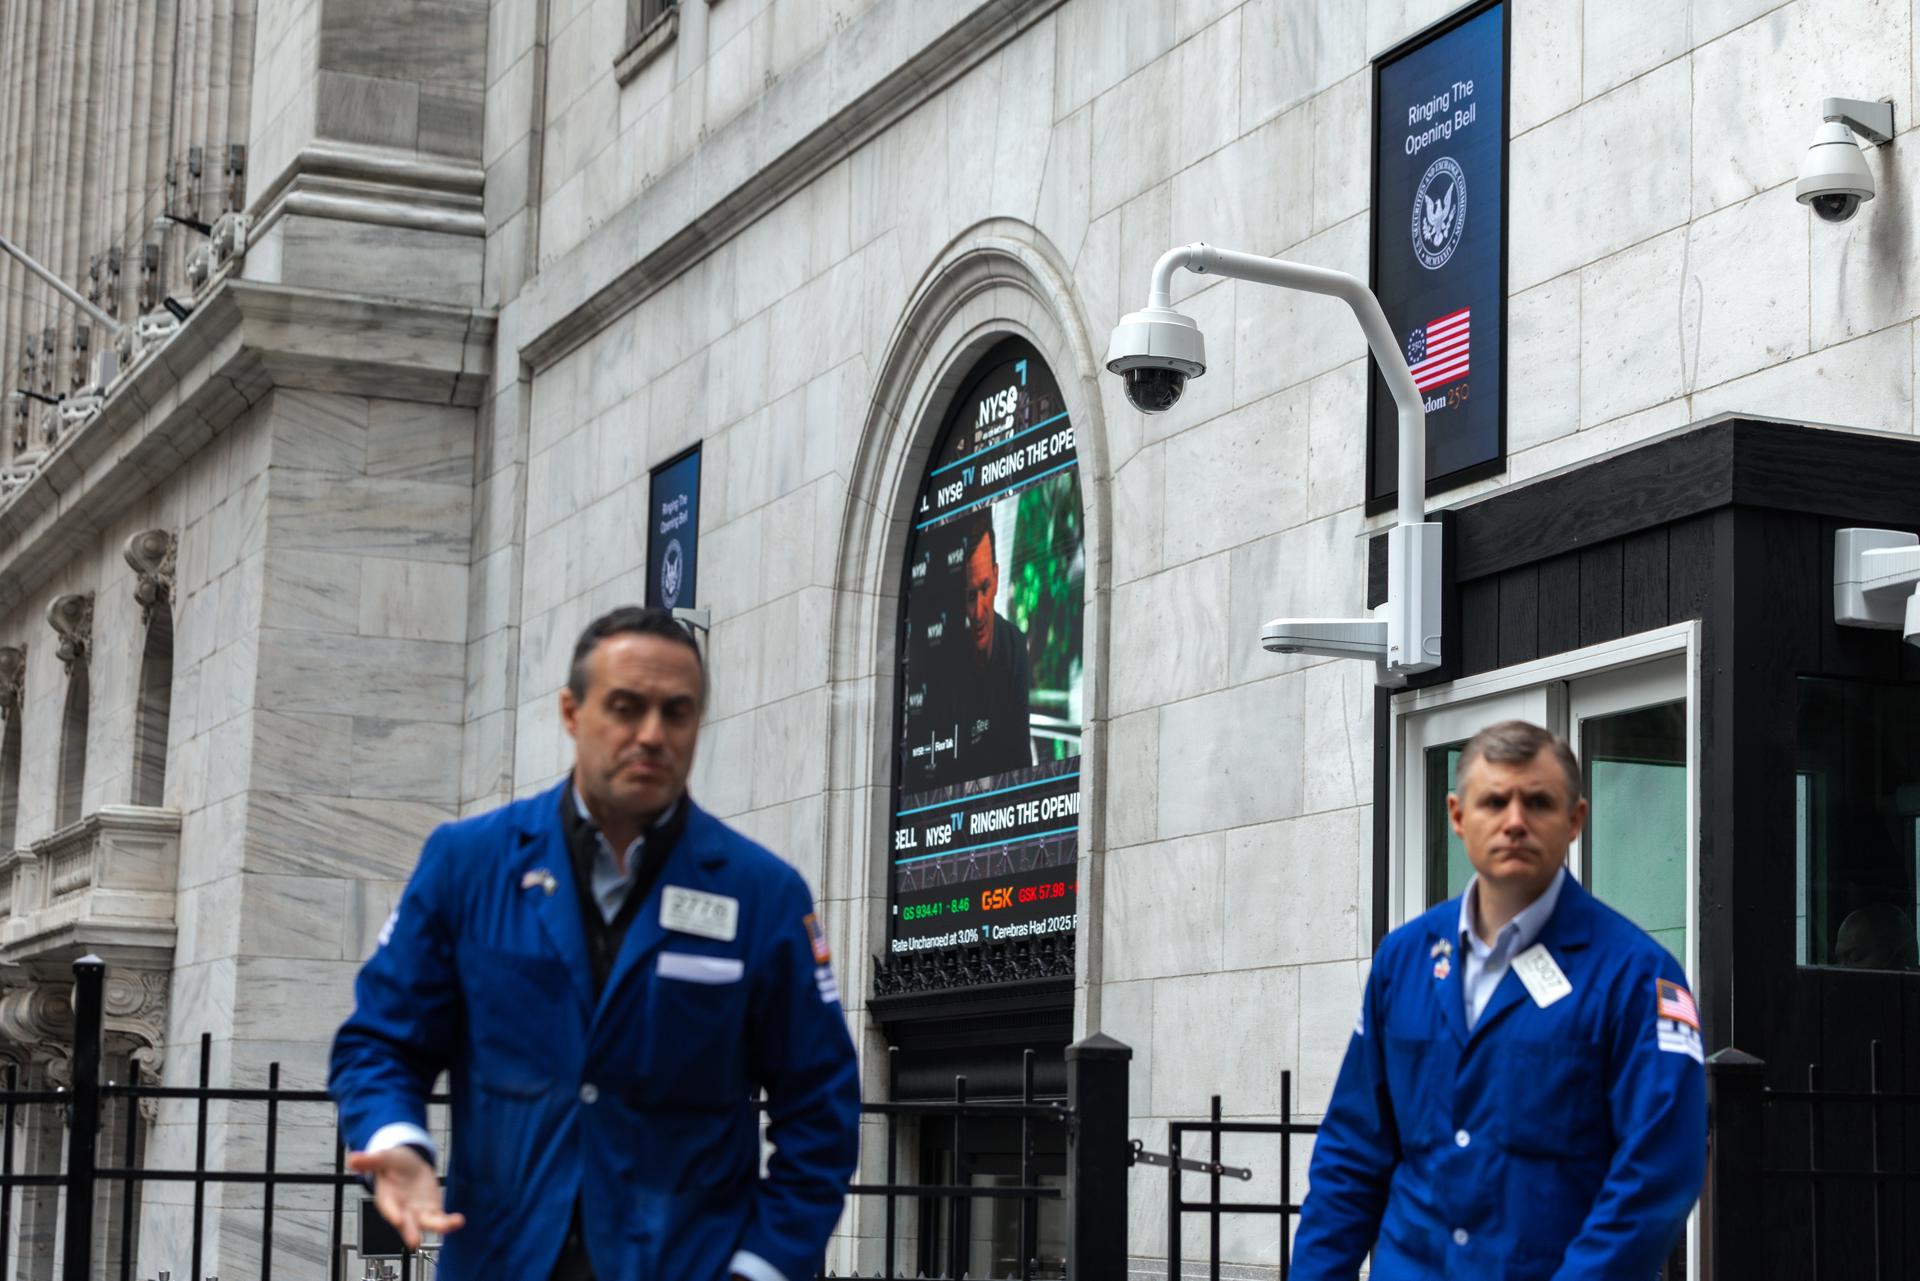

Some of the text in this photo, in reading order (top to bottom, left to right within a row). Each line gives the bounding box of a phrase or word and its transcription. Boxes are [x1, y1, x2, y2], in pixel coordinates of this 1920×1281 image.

[1408, 80, 1474, 126] Ringing The
[1406, 102, 1476, 155] Opening Bell
[1448, 384, 1469, 409] 250
[962, 466, 976, 487] TV
[981, 448, 1025, 486] RINGING
[1026, 438, 1049, 466] THE
[950, 812, 964, 832] TV
[970, 806, 1015, 835] RINGING
[1016, 800, 1040, 825] THE
[982, 886, 1014, 911] GSK
[1018, 886, 1037, 903] GSK
[1039, 882, 1065, 900] 57.98
[903, 905, 915, 920] GS
[916, 902, 942, 918] 934.41
[892, 939, 908, 952] Rate
[949, 932, 957, 945] at
[958, 928, 979, 944] 3.0%
[993, 922, 1029, 940] Cerebras
[1029, 918, 1047, 935] Had
[1047, 915, 1072, 932] 2025
